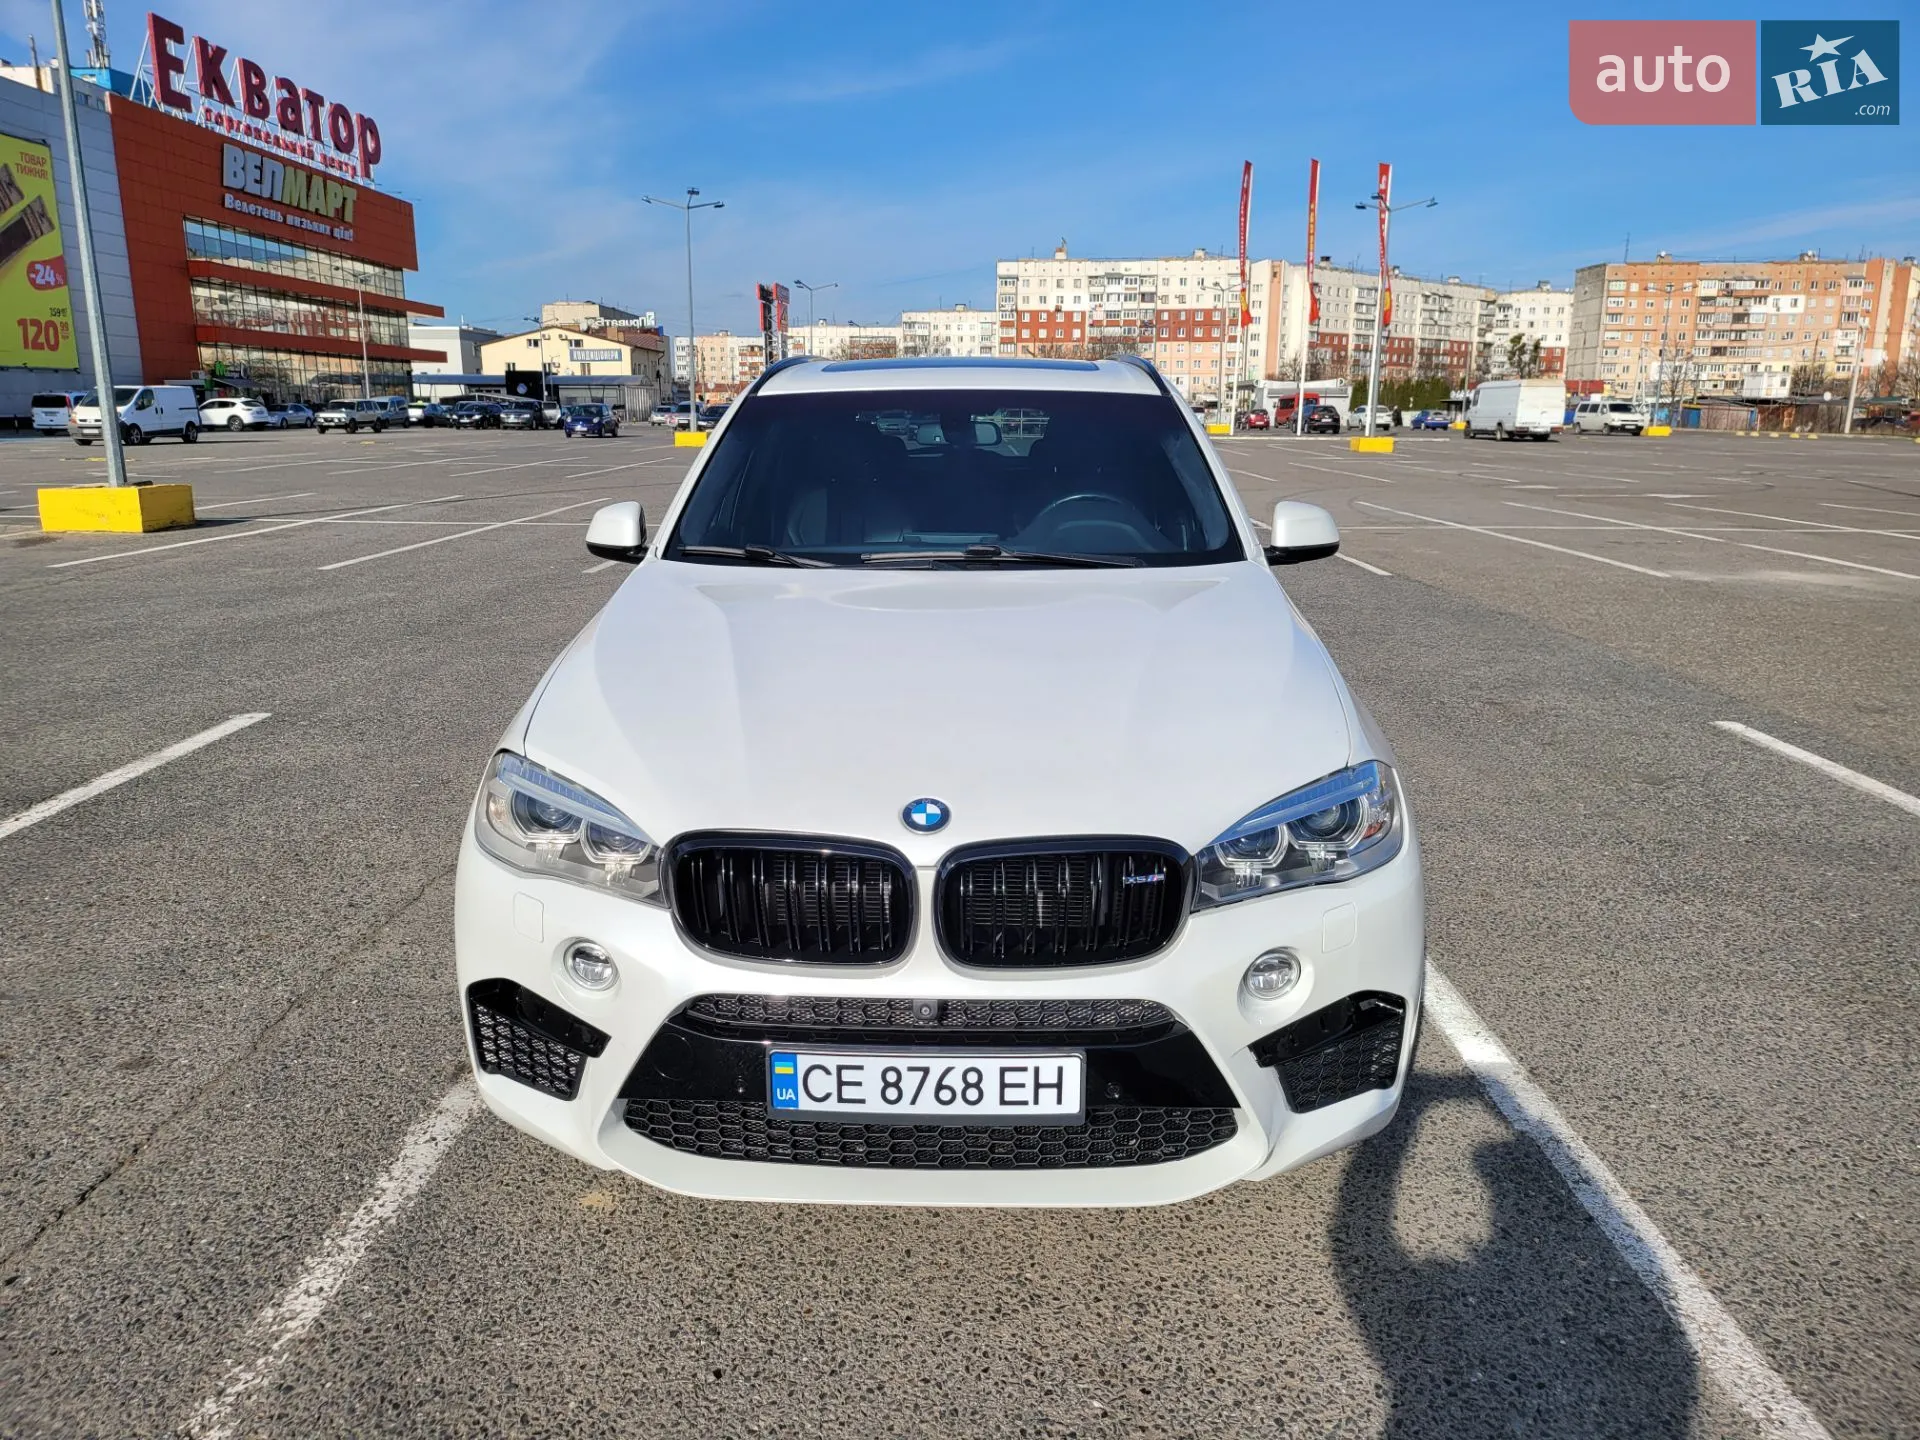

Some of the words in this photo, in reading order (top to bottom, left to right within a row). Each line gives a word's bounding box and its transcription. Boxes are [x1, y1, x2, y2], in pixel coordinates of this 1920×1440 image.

[19, 151, 47, 168] ТОВАР
[222, 143, 357, 223] ВЕЛМАРТ
[17, 318, 60, 352] 120
[776, 1088, 796, 1101] UA
[802, 1064, 866, 1104] CE
[880, 1066, 984, 1106] 8768
[999, 1066, 1063, 1106] EH
